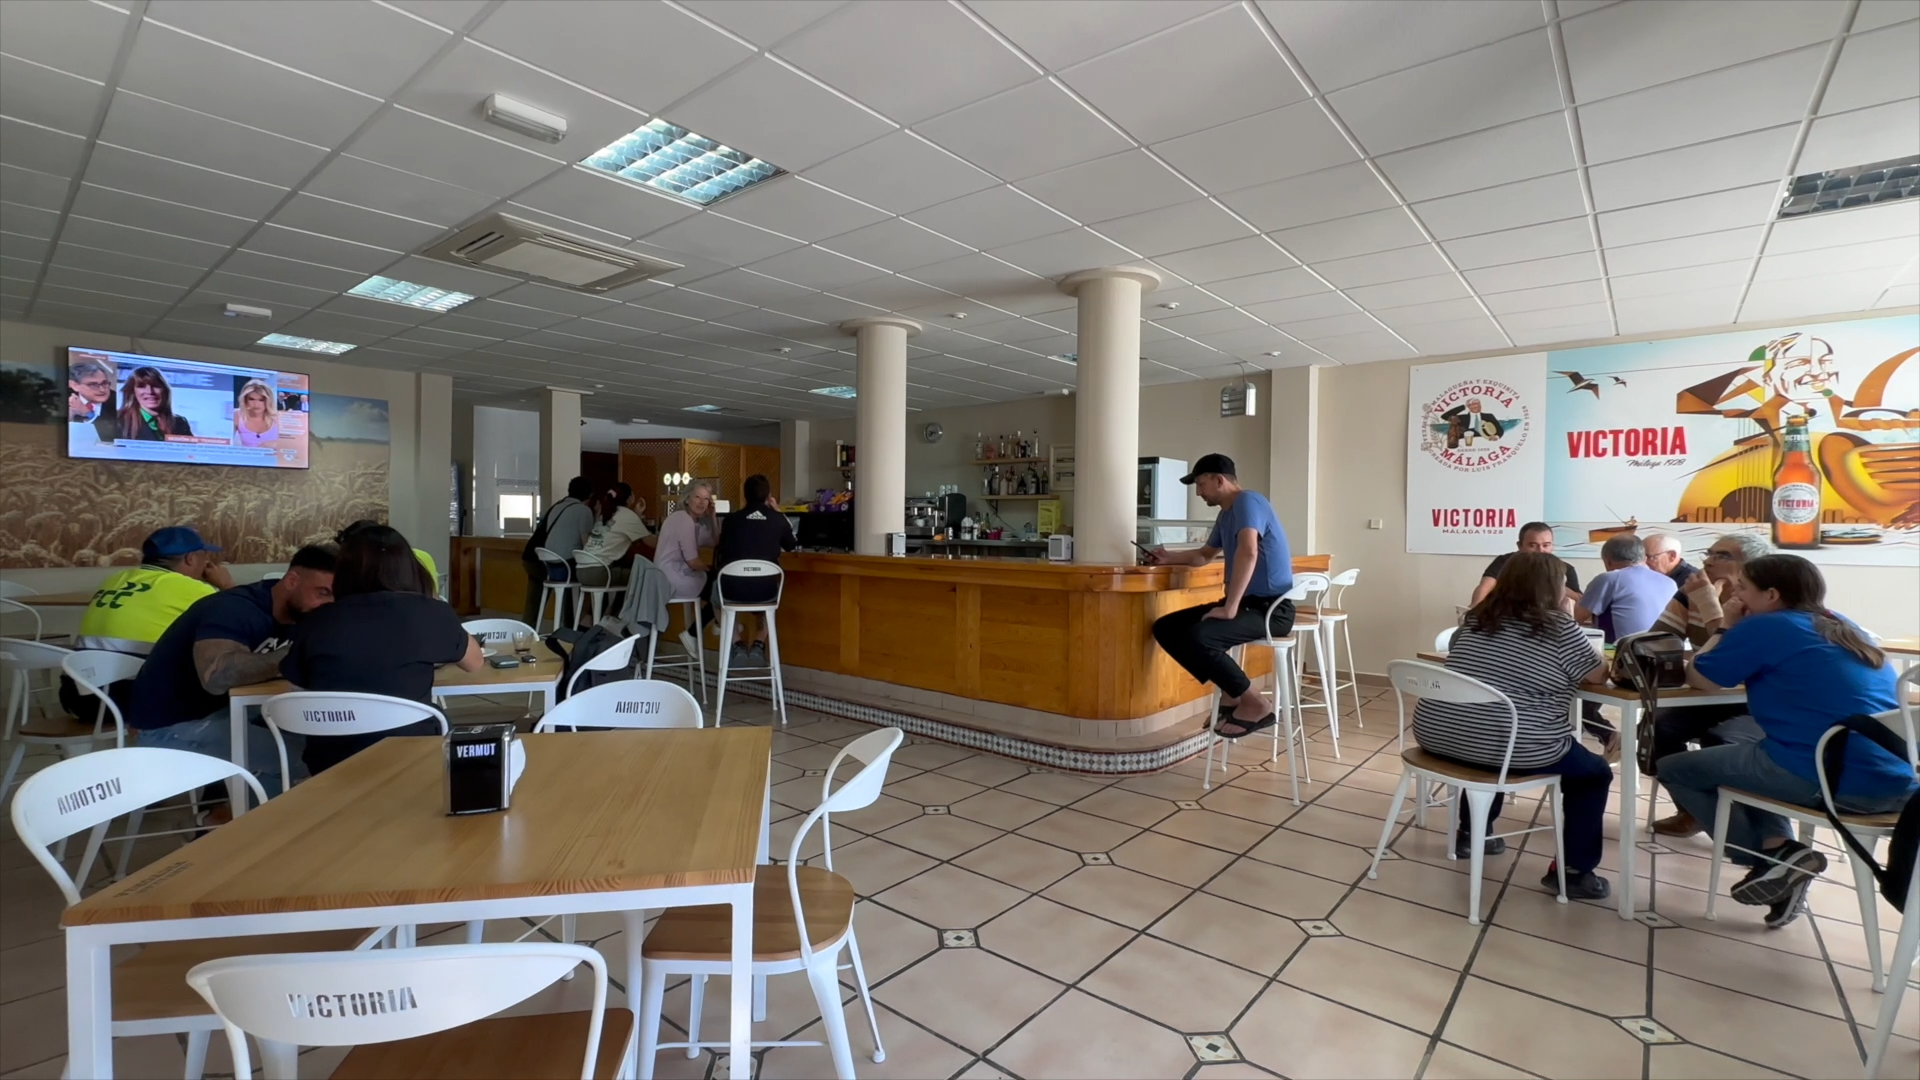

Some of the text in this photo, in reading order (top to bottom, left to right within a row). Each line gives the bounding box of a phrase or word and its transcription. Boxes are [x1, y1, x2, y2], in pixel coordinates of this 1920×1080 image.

[1431, 380, 1473, 406] MALAGUEÑA
[1482, 379, 1520, 400] EXQUISITA
[1433, 385, 1514, 413] VICTORIA
[1567, 426, 1687, 458] VICTORIA
[1428, 449, 1452, 469] CREADA
[1440, 445, 1512, 467] MÁLAGA
[1778, 499, 1814, 508] VICTORIA
[1432, 508, 1516, 528] VICTORIA
[302, 710, 356, 722] VICTORIA
[456, 743, 496, 758] VERMUT
[286, 986, 418, 1018] VICTORIA
